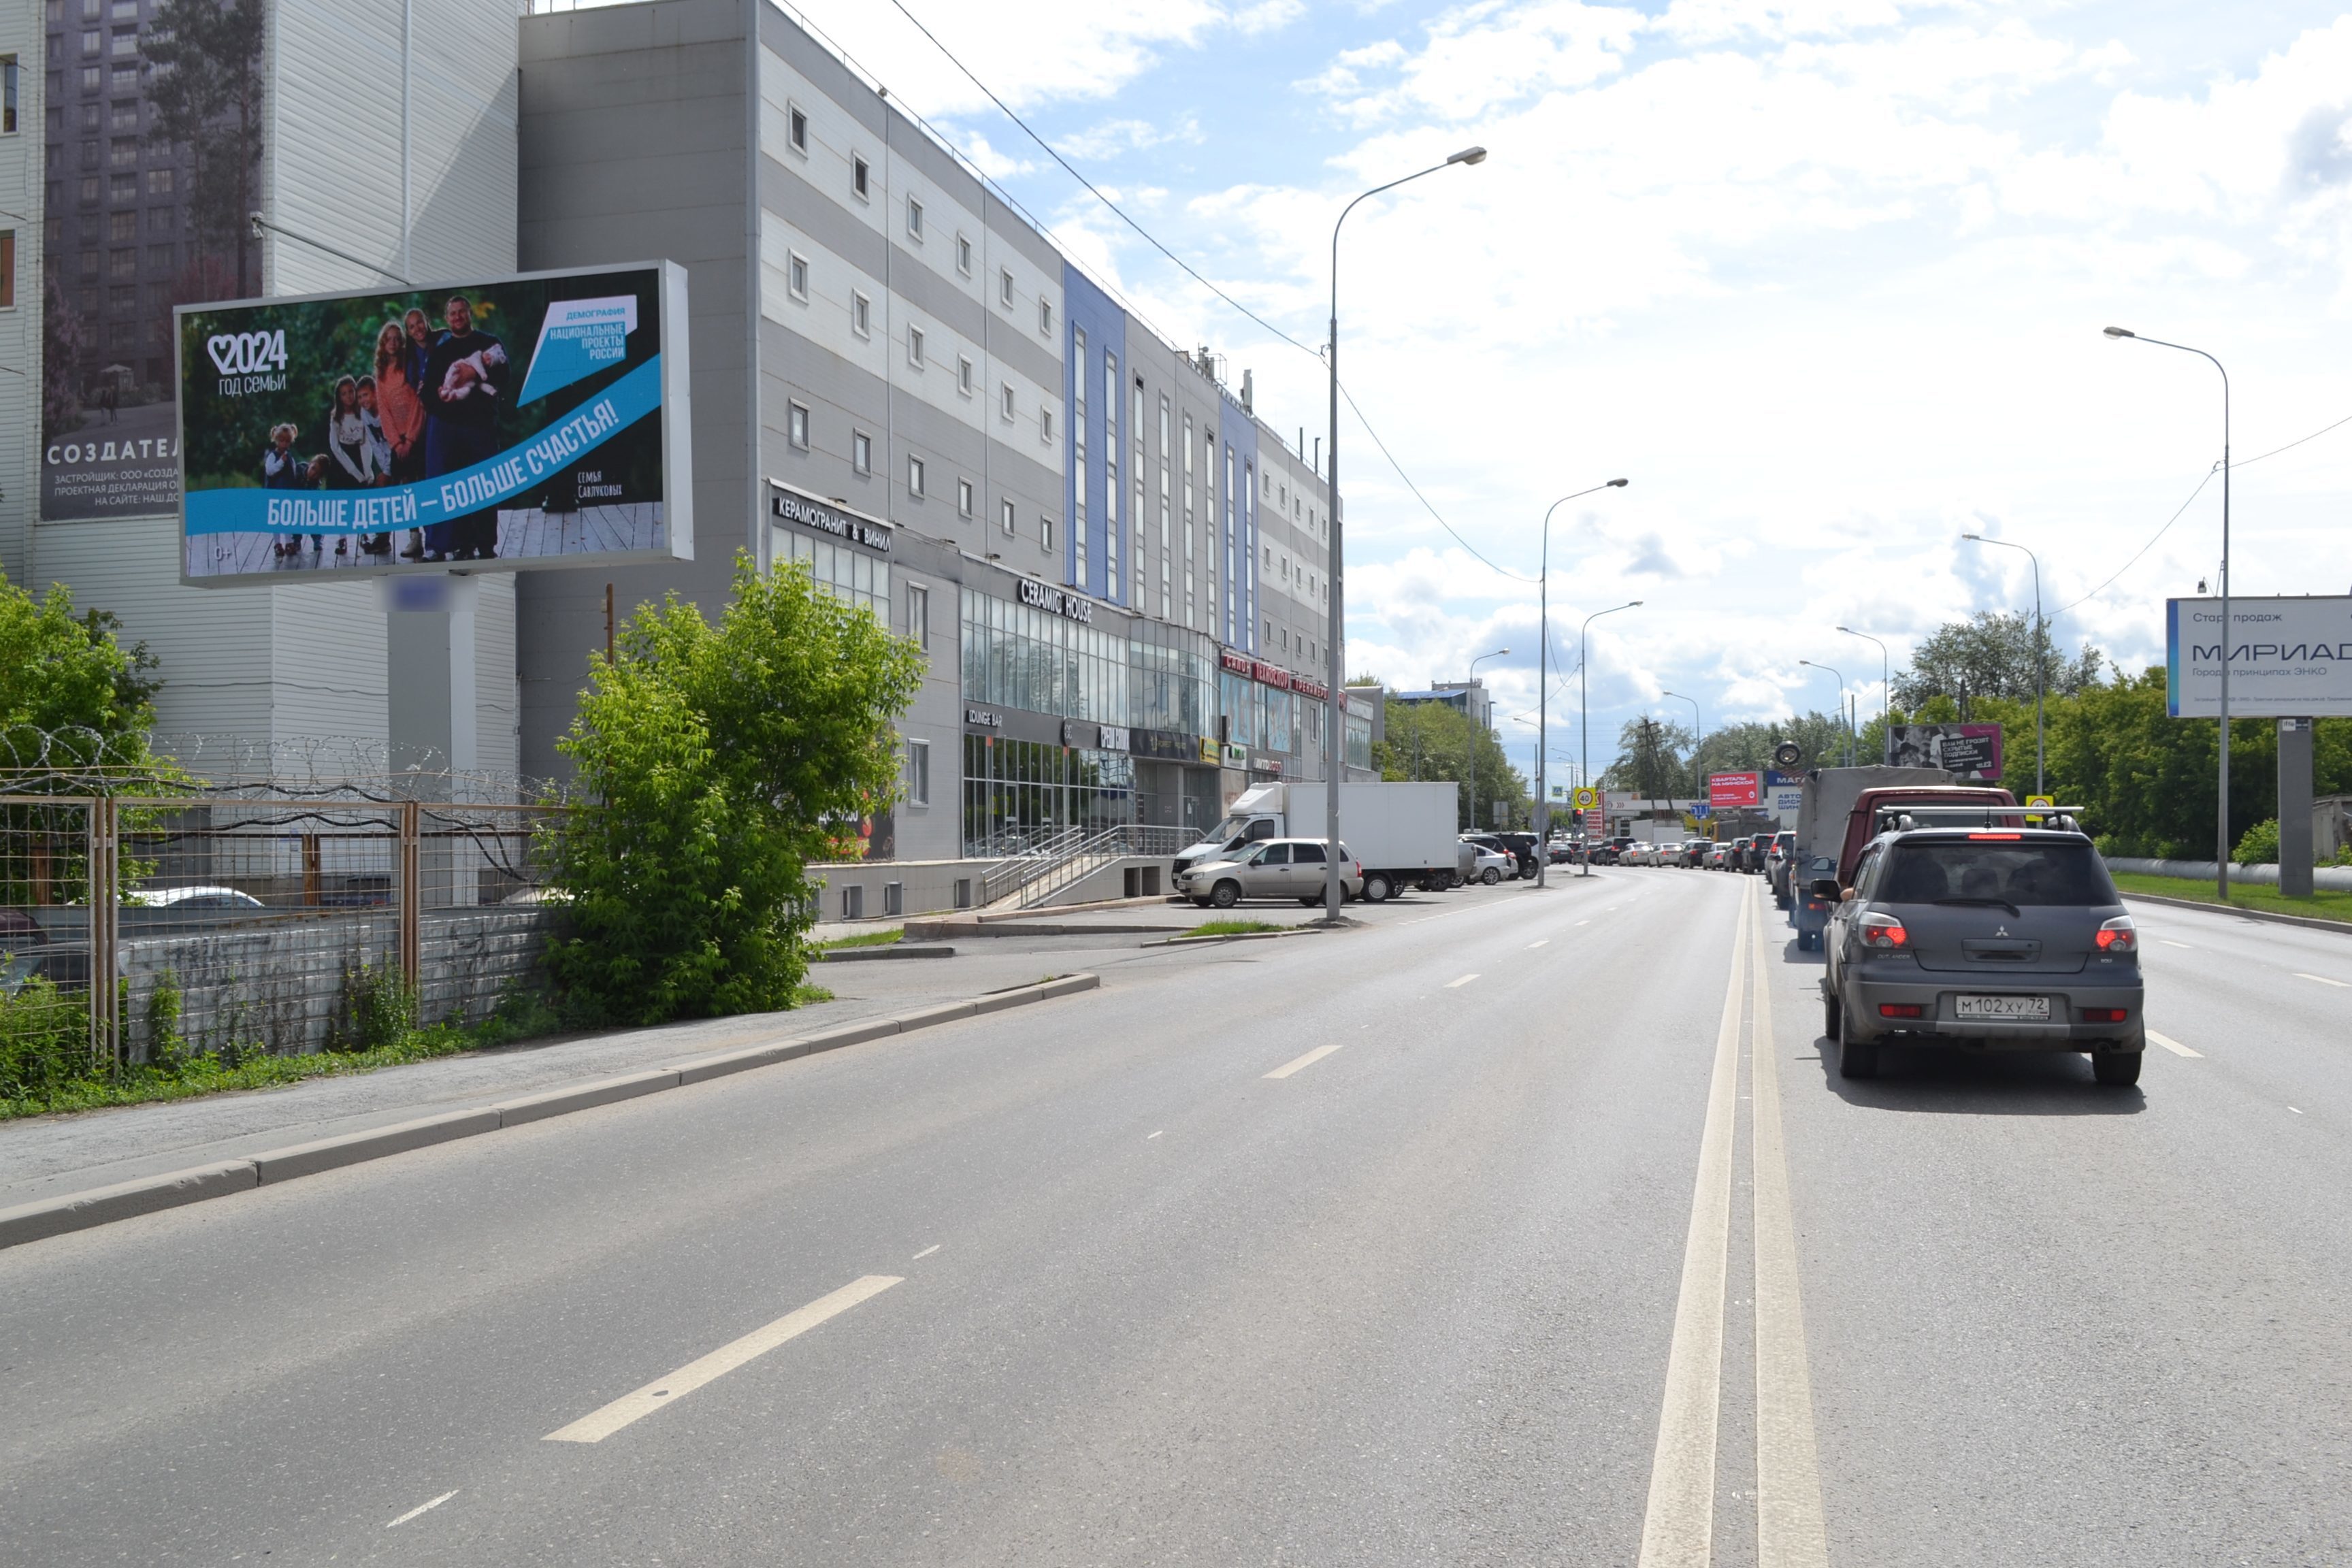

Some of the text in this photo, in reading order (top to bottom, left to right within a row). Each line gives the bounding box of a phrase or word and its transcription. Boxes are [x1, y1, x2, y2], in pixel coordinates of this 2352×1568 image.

[566, 308, 625, 321] ДЕМОГРАФИЯ
[550, 323, 624, 340] НАЦИОНАЛЬНЫЕ
[582, 336, 624, 349] ПРОЕКТЫ
[208, 329, 288, 375] 2024
[589, 348, 624, 360] РОССИИ
[267, 497, 348, 526] БОЛЬШЕ
[352, 488, 417, 530] ДЕТЕЙ
[440, 457, 528, 512] БОЛЬШЕ
[525, 399, 620, 476] СЧАСТЬЯ!
[55, 471, 118, 484] ЗАСТРОЙЩИК:
[121, 471, 142, 480] ООО
[578, 470, 602, 484] СЕМЬЯ
[54, 485, 105, 496] ПРОЕКТНАЯ
[108, 482, 167, 494] ДЕКЛАРАЦИЯ
[95, 497, 108, 506] НА
[110, 494, 141, 505] САЙТЕ:
[143, 494, 164, 503] НАШ
[779, 497, 847, 536] КЕРАМОГРАНИТ
[864, 528, 891, 552] ВИНИЛ
[214, 546, 231, 560] 0+
[1022, 579, 1092, 623] CERAMIC HOUSE
[2234, 613, 2283, 623] продаж
[2193, 667, 2328, 677] Город принципах ЭНКО
